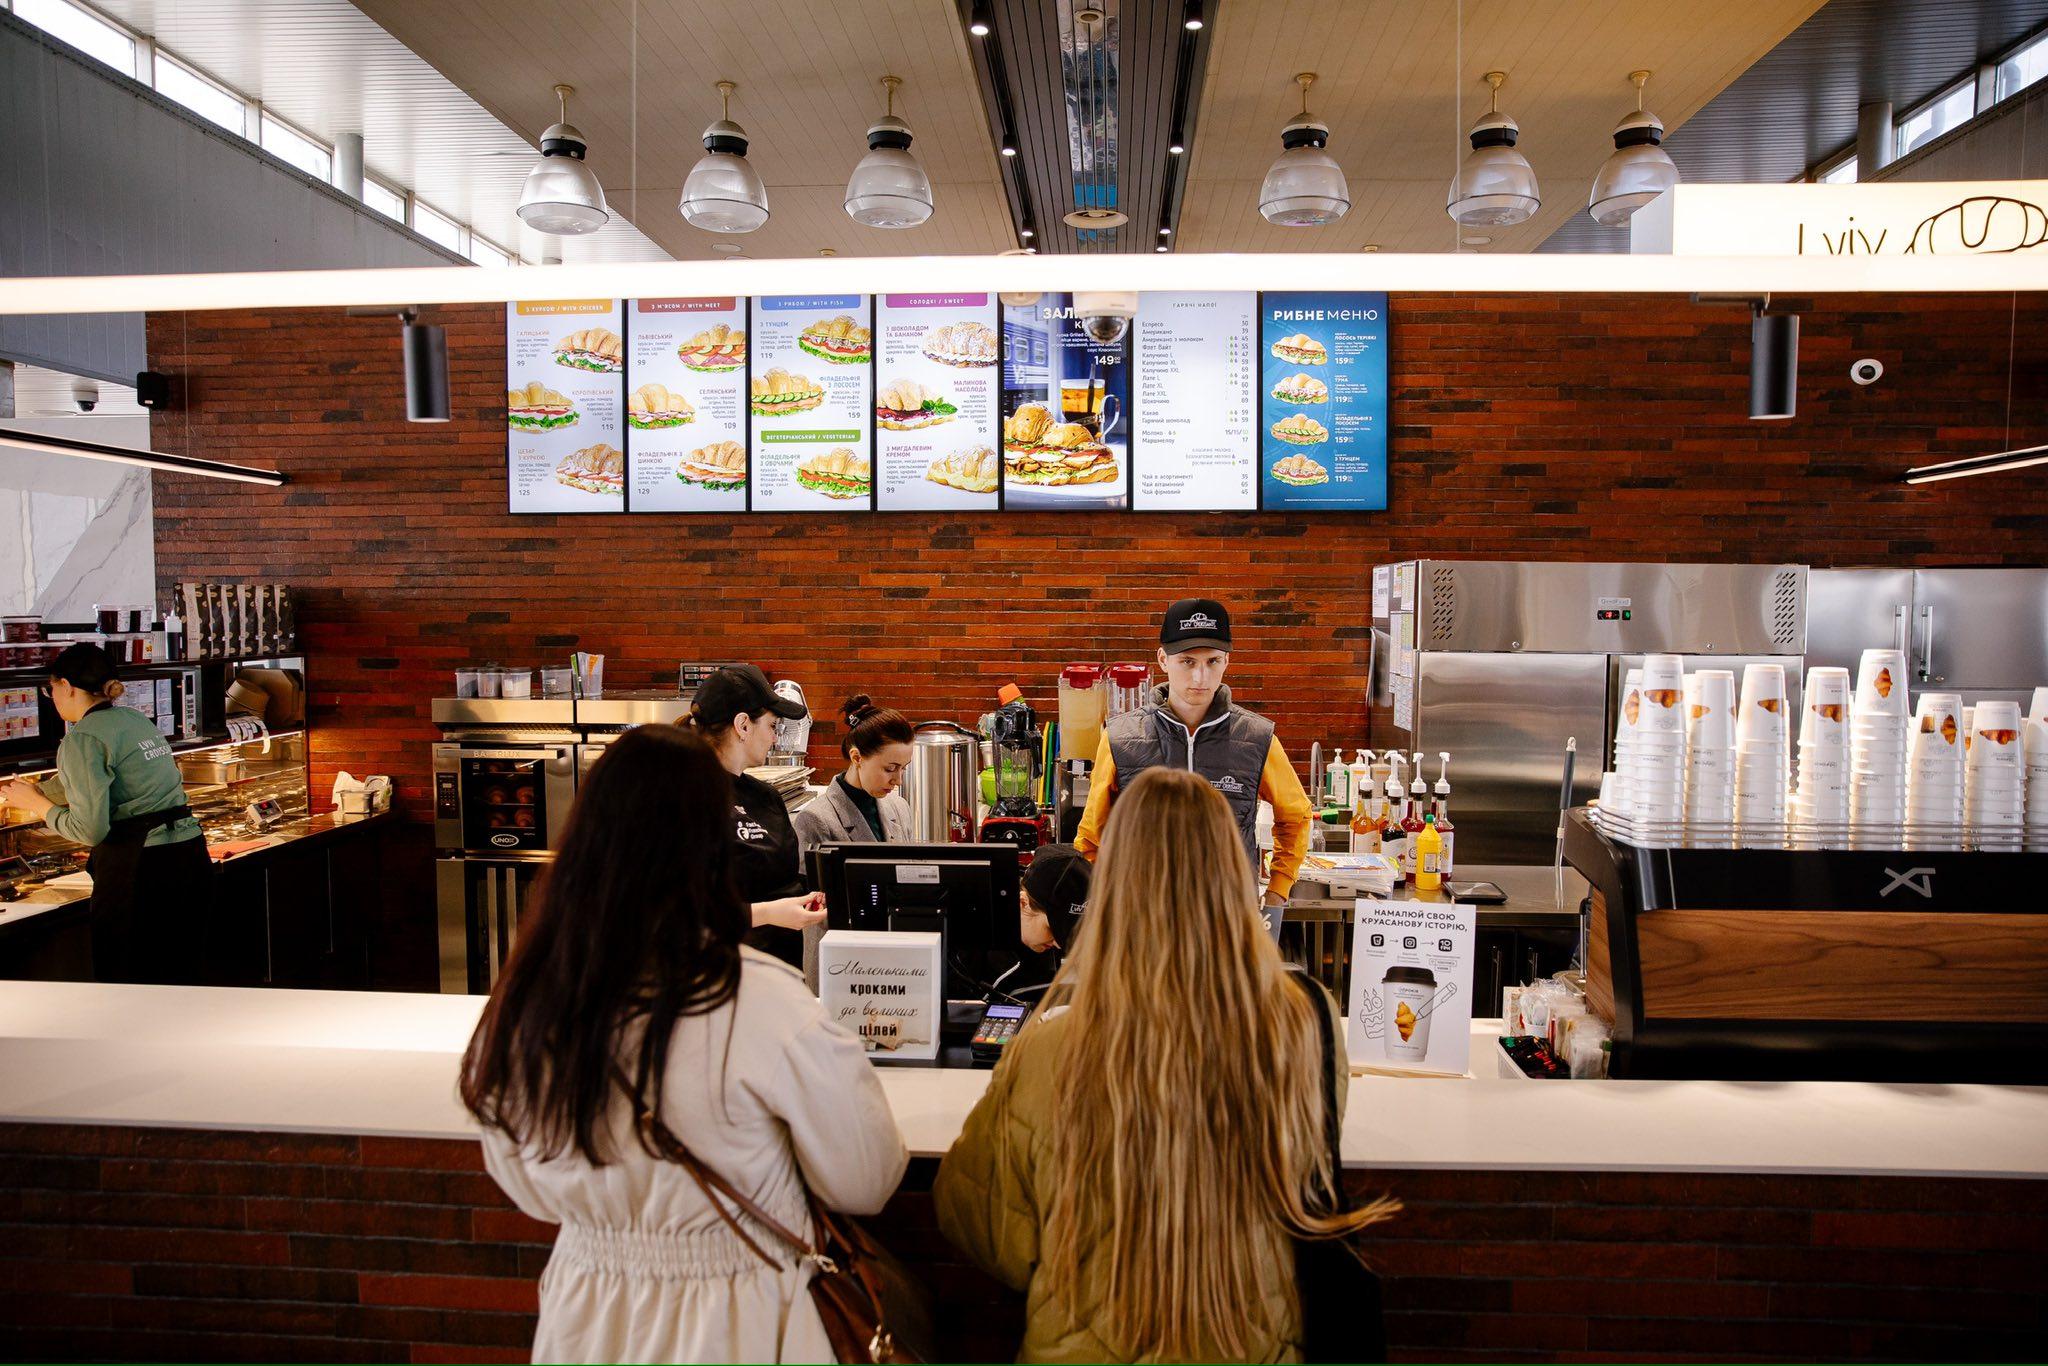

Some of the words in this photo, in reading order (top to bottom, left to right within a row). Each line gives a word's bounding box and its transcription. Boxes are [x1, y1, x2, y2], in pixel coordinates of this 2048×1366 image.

[1273, 310, 1324, 321] РИБНЕ
[1094, 356, 1114, 365] 149
[1374, 909, 1424, 919] НАМАЛЮЙ
[1427, 912, 1456, 921] СВОЮ
[1361, 918, 1422, 928] КРУАСАНОВУ
[1424, 922, 1468, 932] ІСТОРІЮ,
[828, 960, 928, 977] Маленькими
[850, 984, 906, 996] кроками
[838, 1006, 857, 1020] до
[863, 1000, 918, 1017] великих
[859, 1023, 898, 1036] цілей
